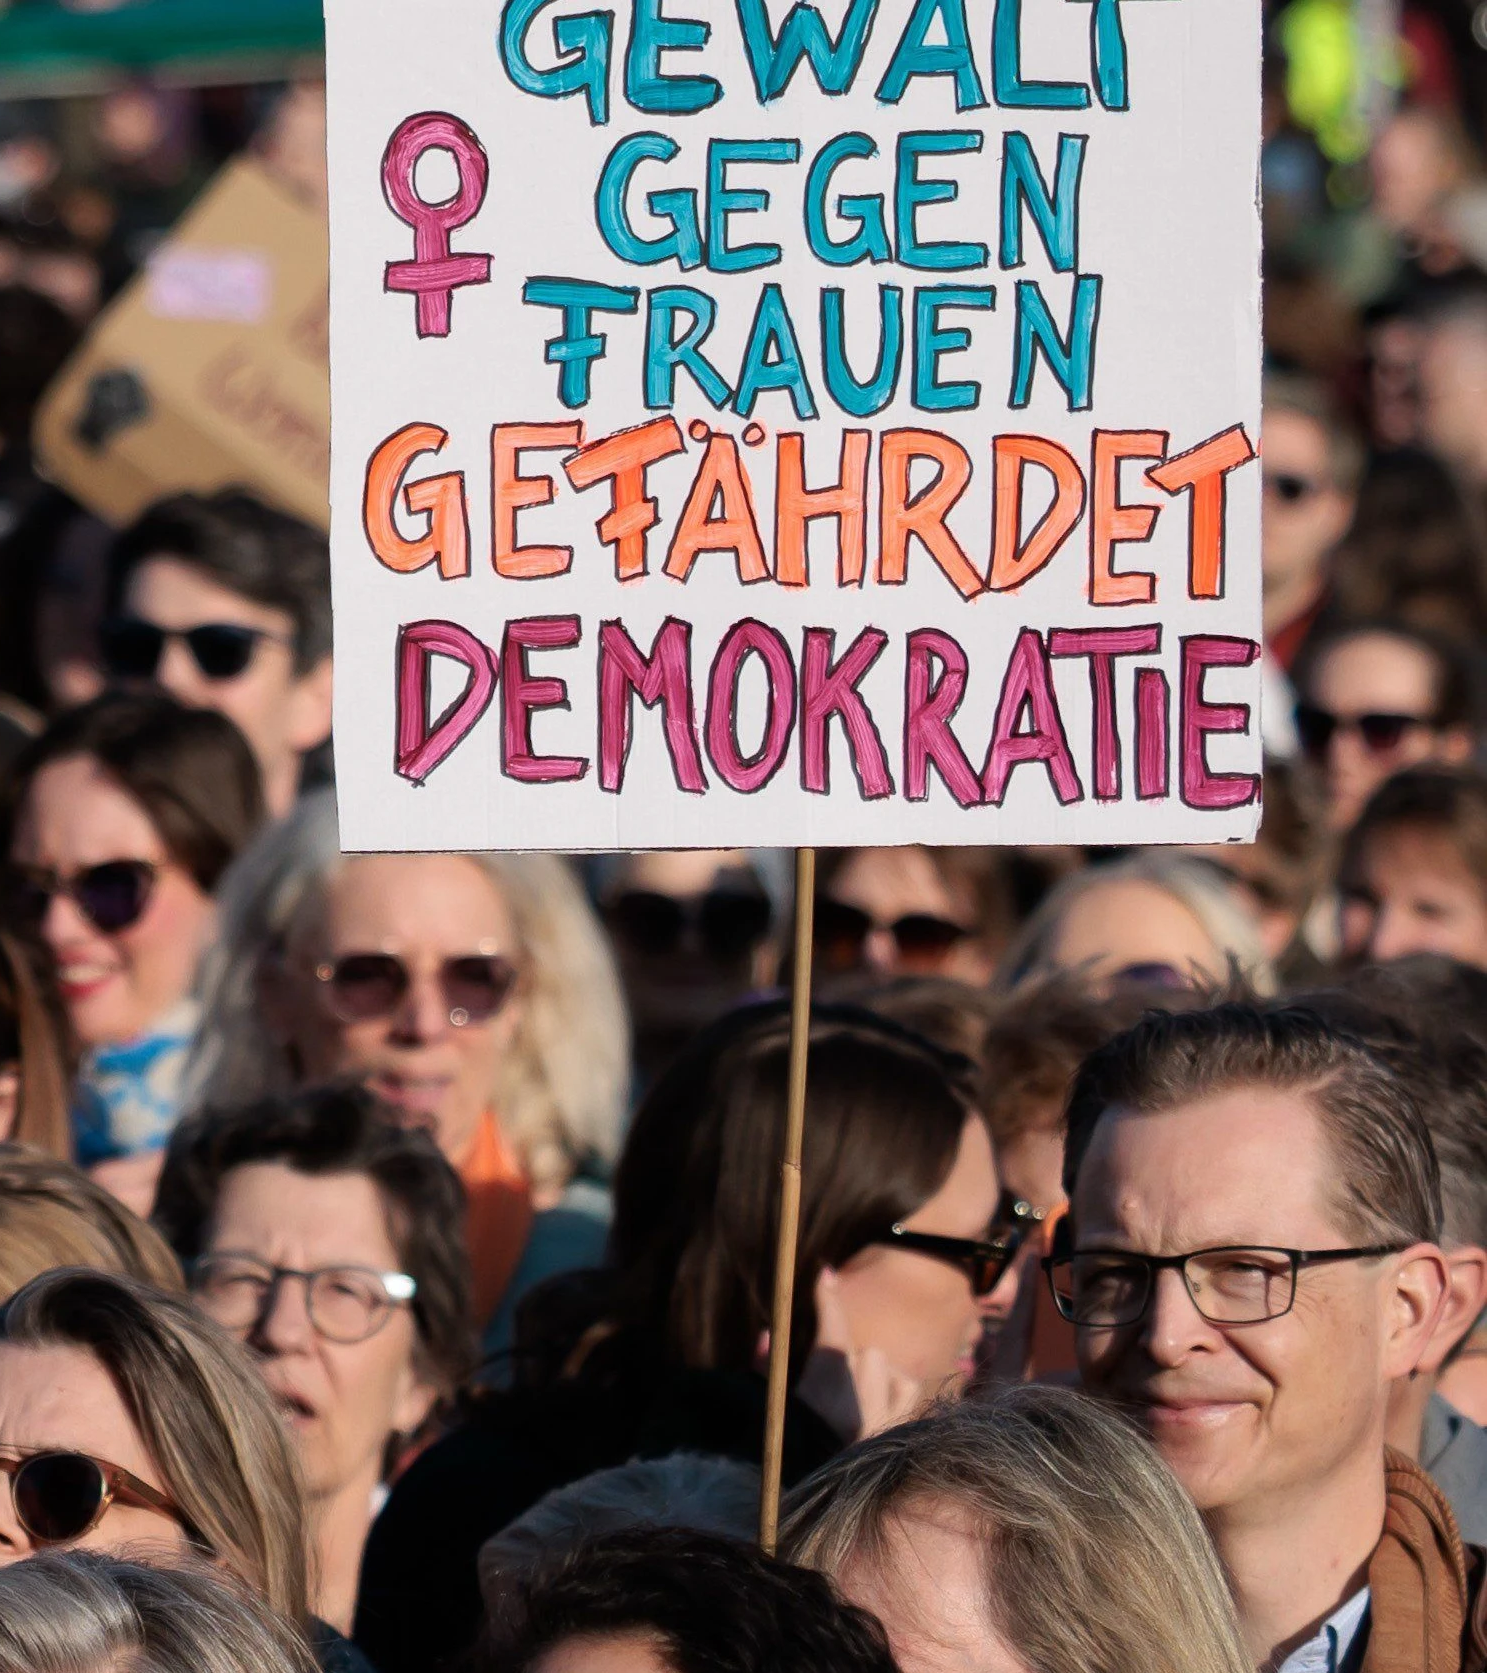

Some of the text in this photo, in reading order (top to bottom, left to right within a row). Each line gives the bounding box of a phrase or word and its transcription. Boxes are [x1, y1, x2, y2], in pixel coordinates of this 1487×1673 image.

[594, 130, 1090, 274] GEGEN
[522, 273, 1103, 421] FRAUEN
[361, 414, 1256, 608] GEFÄHRDET
[393, 614, 1261, 811] DEMOKRATIE
